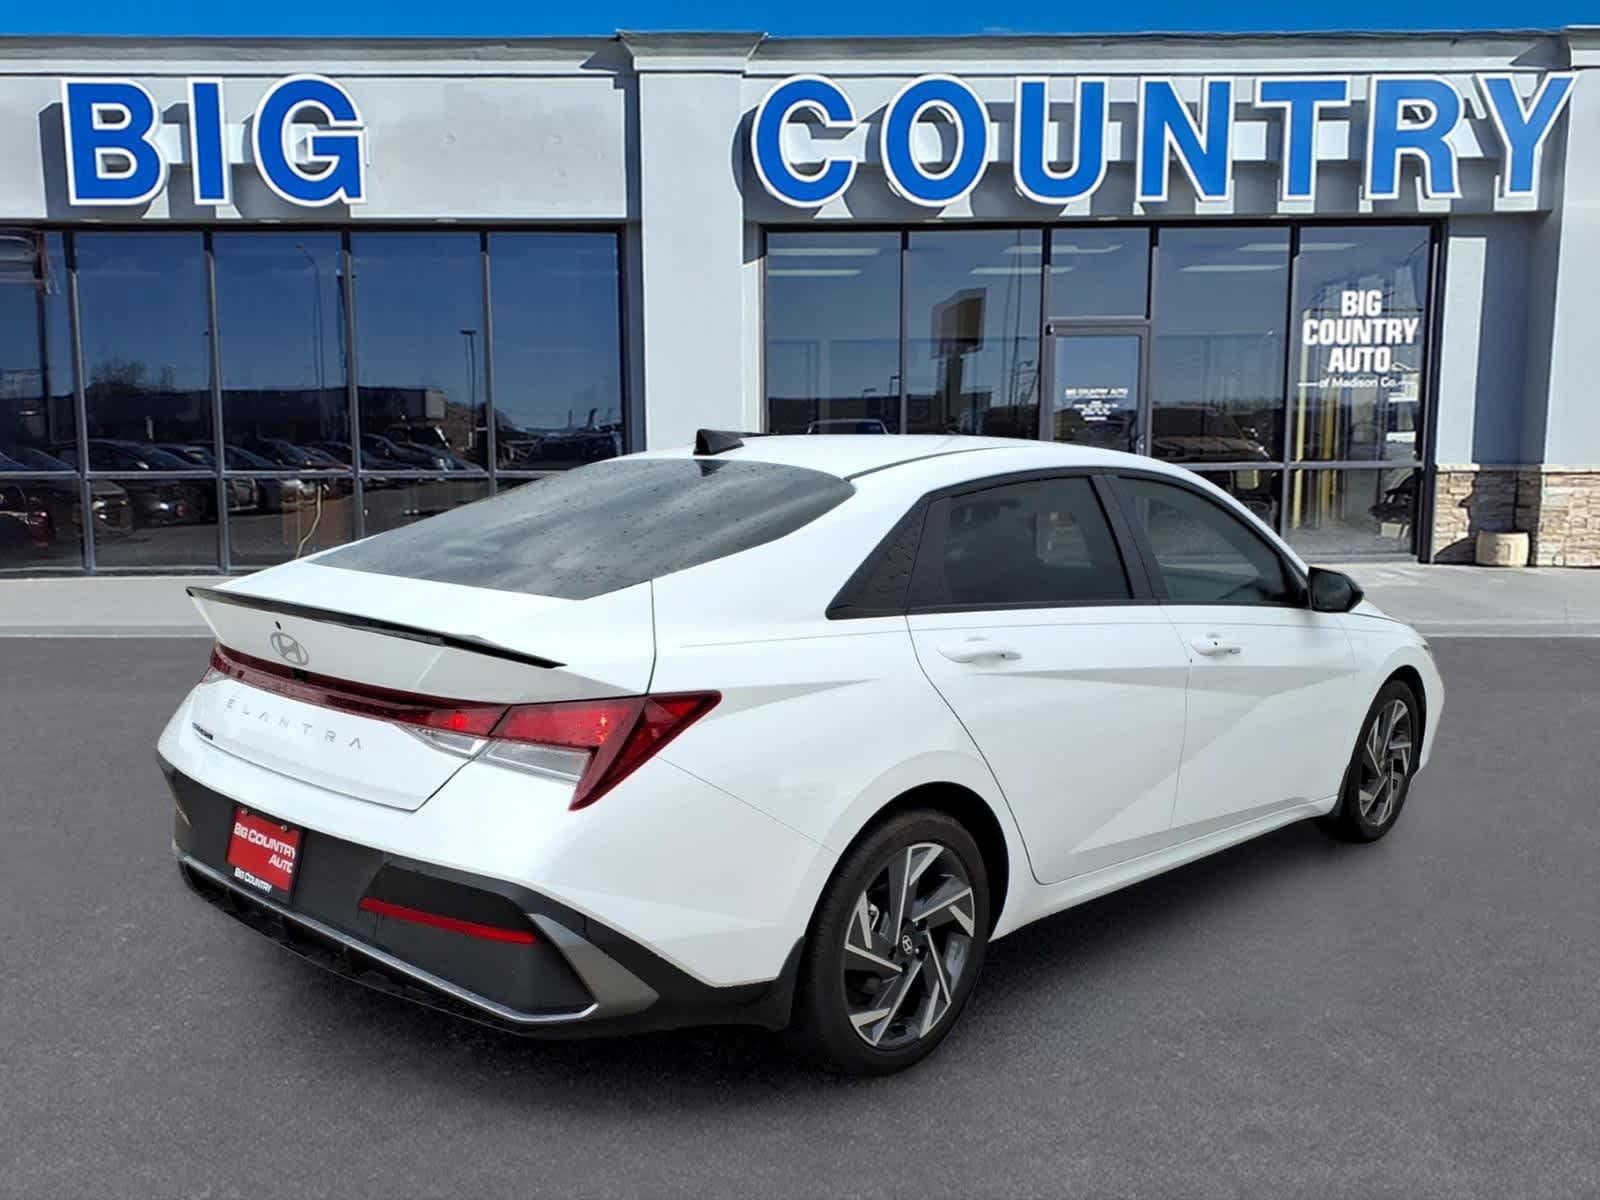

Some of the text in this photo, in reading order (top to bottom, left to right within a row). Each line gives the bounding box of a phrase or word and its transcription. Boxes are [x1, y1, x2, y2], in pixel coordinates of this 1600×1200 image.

[61, 73, 1574, 208] BIG COUNTRY
[1341, 289, 1383, 317] BIG
[1302, 317, 1420, 346] COUNTRY
[1327, 347, 1392, 373] AUTO
[226, 698, 363, 750] ELANTRA
[248, 829, 296, 859] COUNTRY
